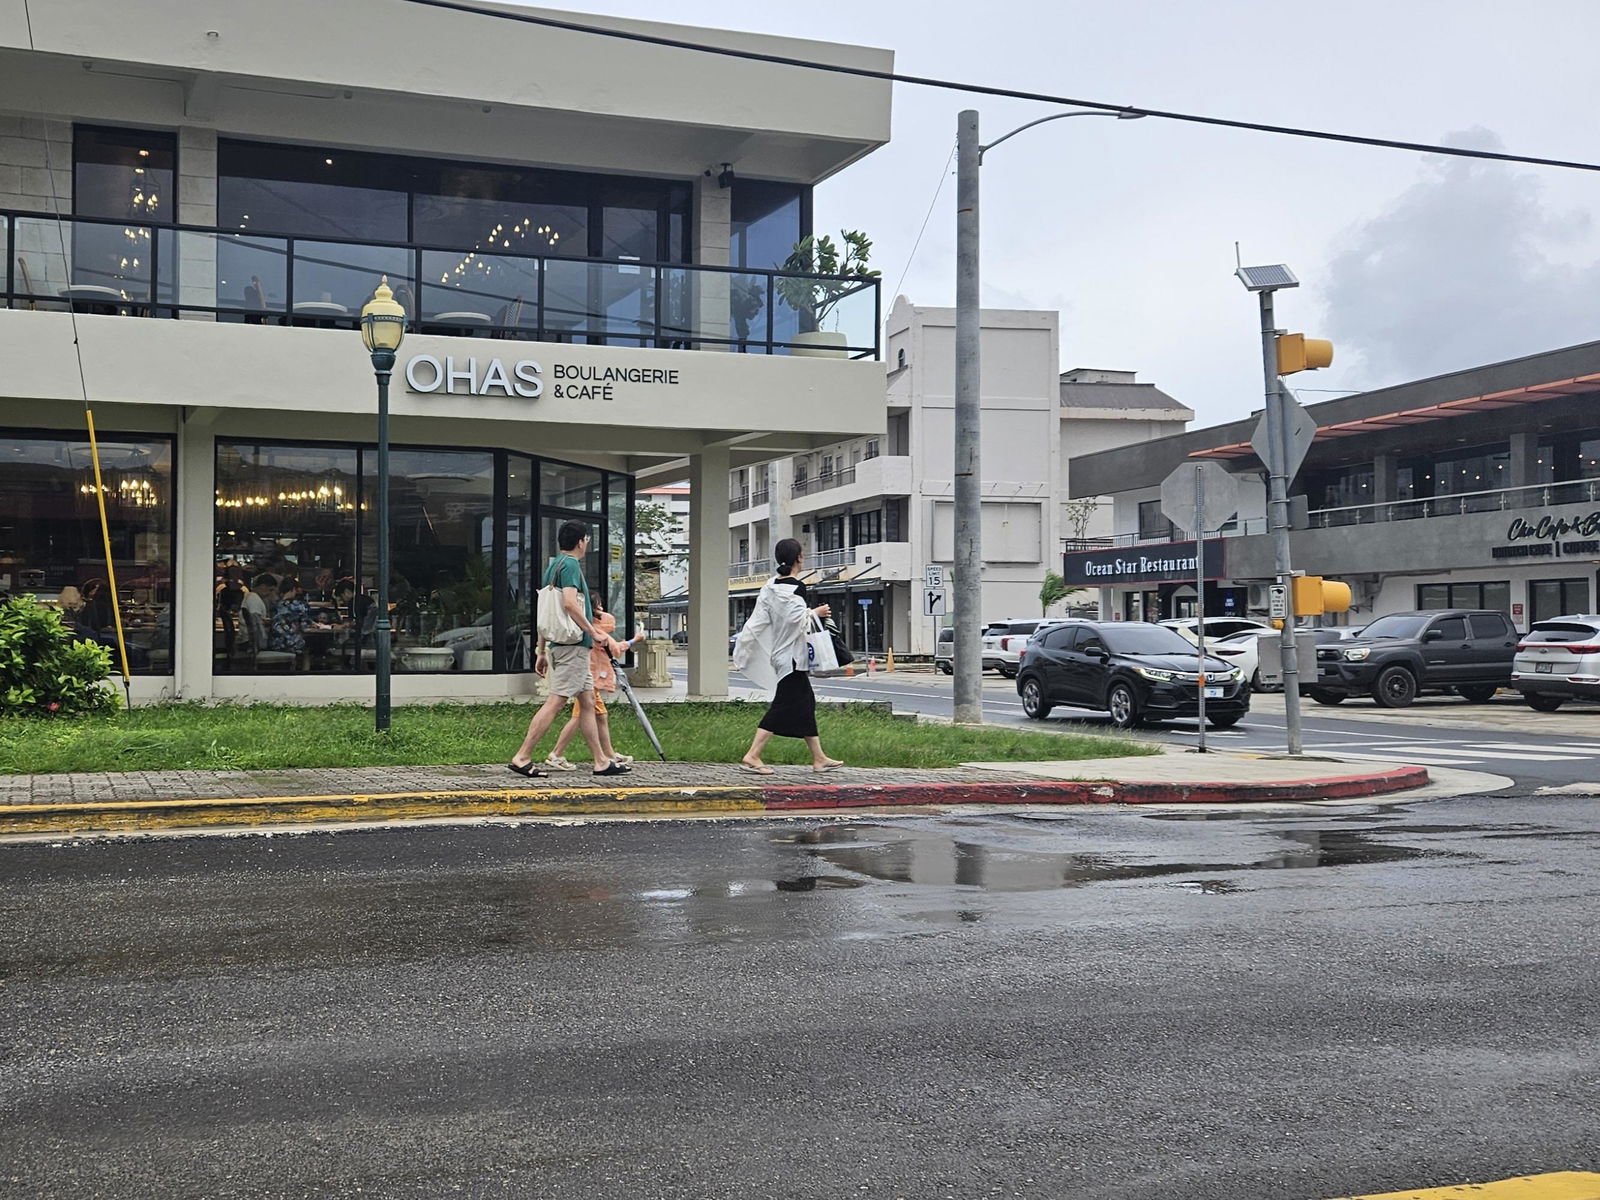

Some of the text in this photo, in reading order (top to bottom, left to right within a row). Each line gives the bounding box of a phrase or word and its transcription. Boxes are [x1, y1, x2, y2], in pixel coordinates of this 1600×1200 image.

[405, 354, 543, 397] OHAS
[554, 364, 679, 385] BOULANGERIE
[1085, 561, 1113, 576] Ocean
[1115, 558, 1137, 574] Star
[929, 576, 941, 585] 15
